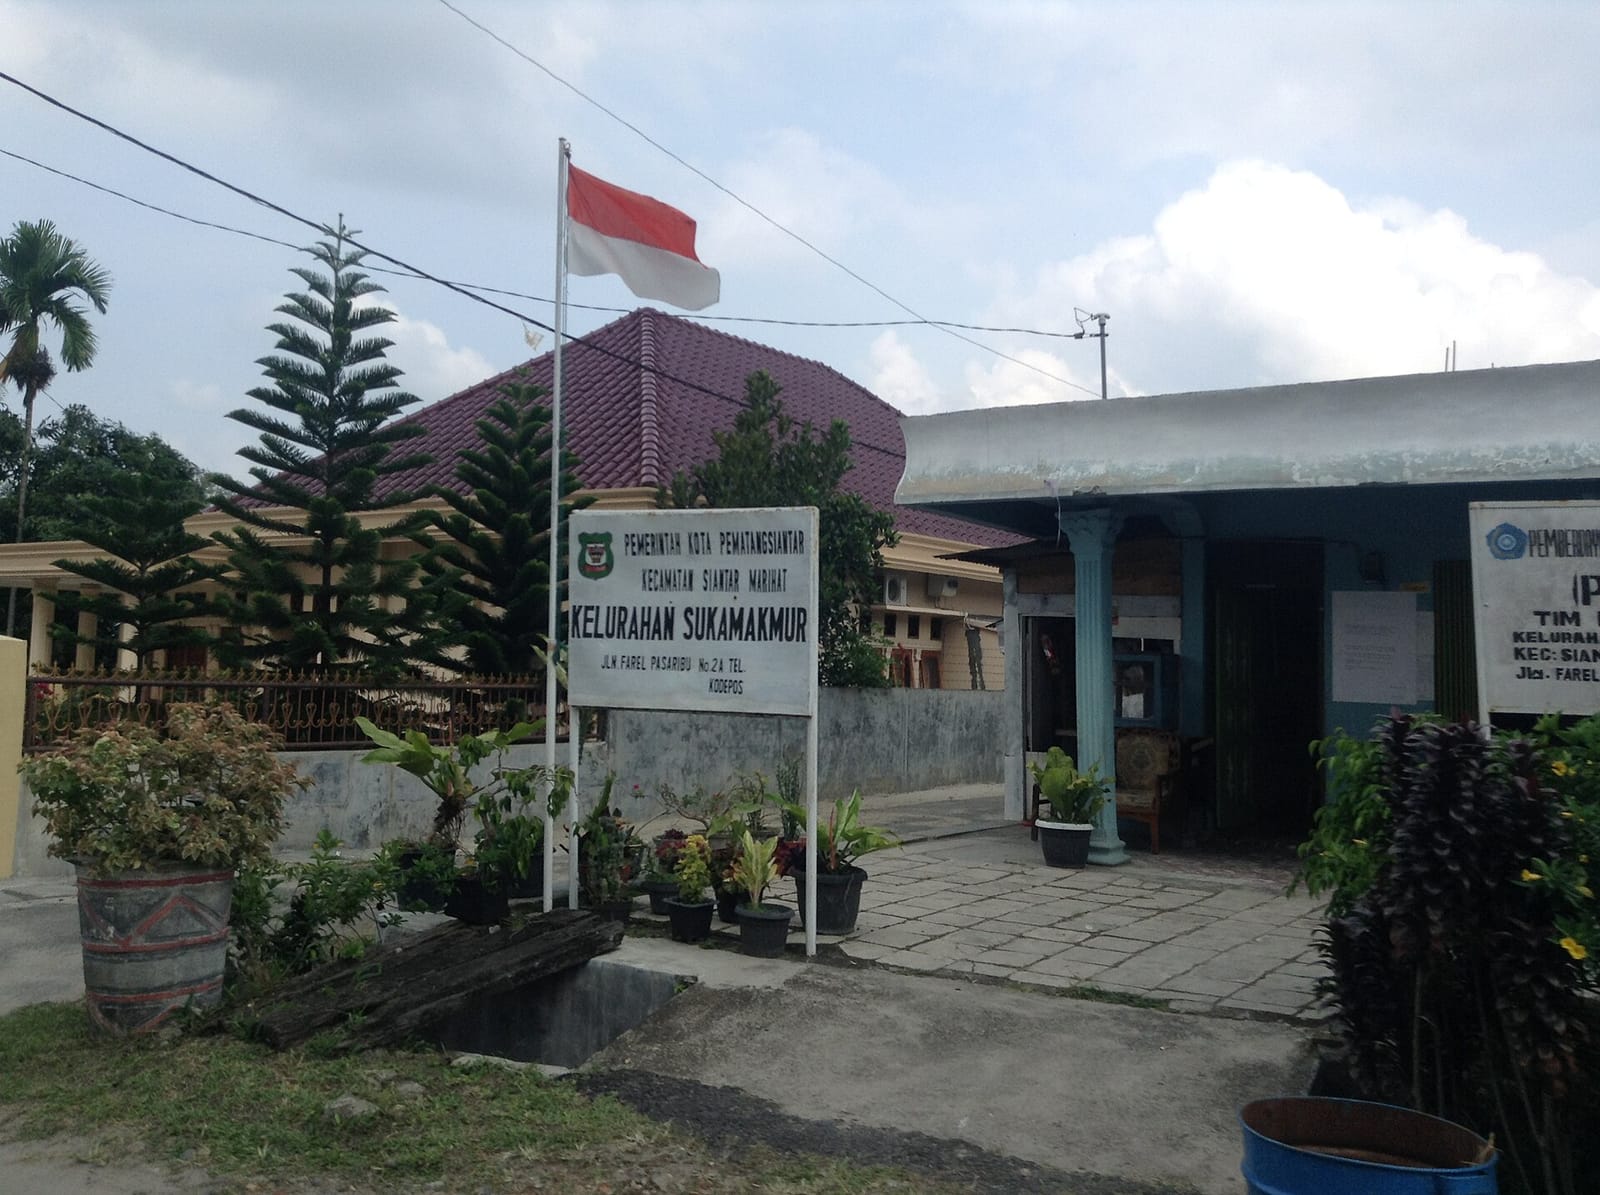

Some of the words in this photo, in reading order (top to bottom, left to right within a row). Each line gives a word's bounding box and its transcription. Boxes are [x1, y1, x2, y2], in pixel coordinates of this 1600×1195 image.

[624, 532, 681, 556] PEMERINTAH
[688, 532, 712, 555] KOTA
[719, 530, 805, 555] PEMATANGSIANTAR
[642, 568, 693, 592] KECAMATAN
[703, 569, 740, 592] SIANTAR
[749, 569, 787, 592] MARIHAT
[571, 604, 675, 641] KELURAHAN
[683, 606, 807, 642] SUKAMAKMUR
[1533, 610, 1581, 627] TIM
[651, 656, 691, 672] PASARIBU
[1555, 667, 1600, 682] FAREL
[709, 679, 743, 695] KODEPOS
